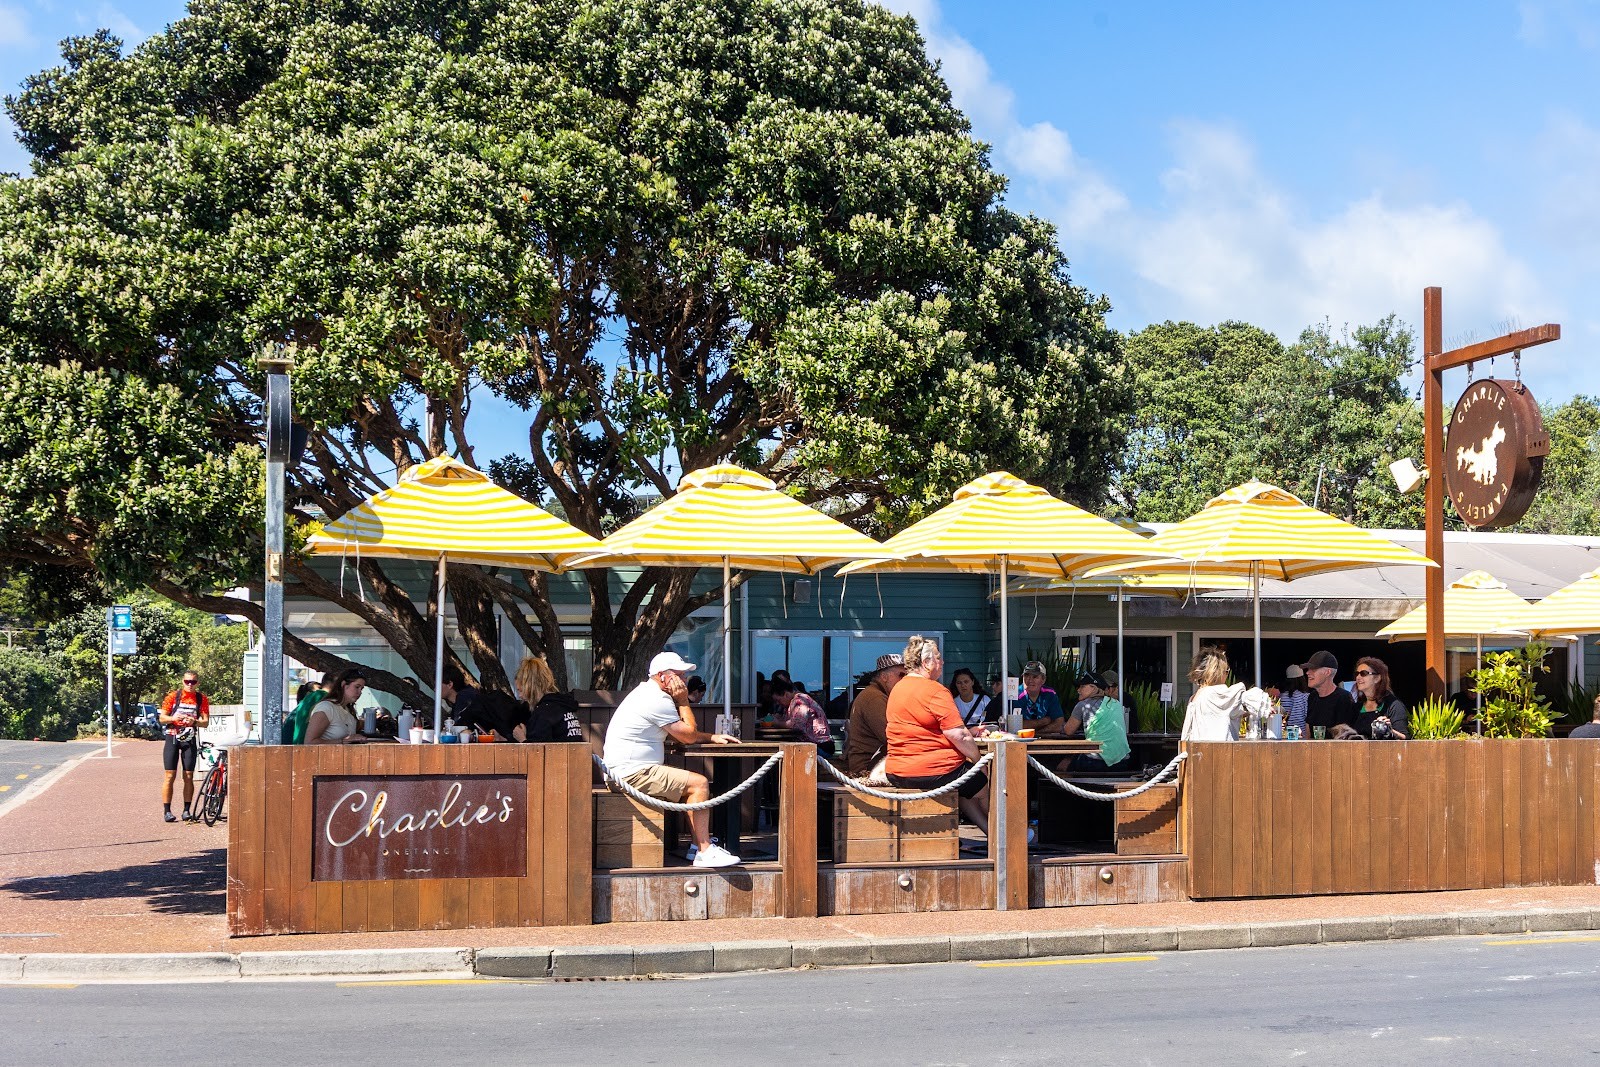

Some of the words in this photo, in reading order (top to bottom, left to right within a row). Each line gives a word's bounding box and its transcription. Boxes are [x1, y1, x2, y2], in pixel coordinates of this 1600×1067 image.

[1457, 386, 1506, 424] CHARLIE
[1456, 482, 1508, 520] FARLEY'S
[210, 716, 227, 726] IVE
[326, 782, 514, 847] Charlie's
[382, 847, 457, 856] ONETANGI
